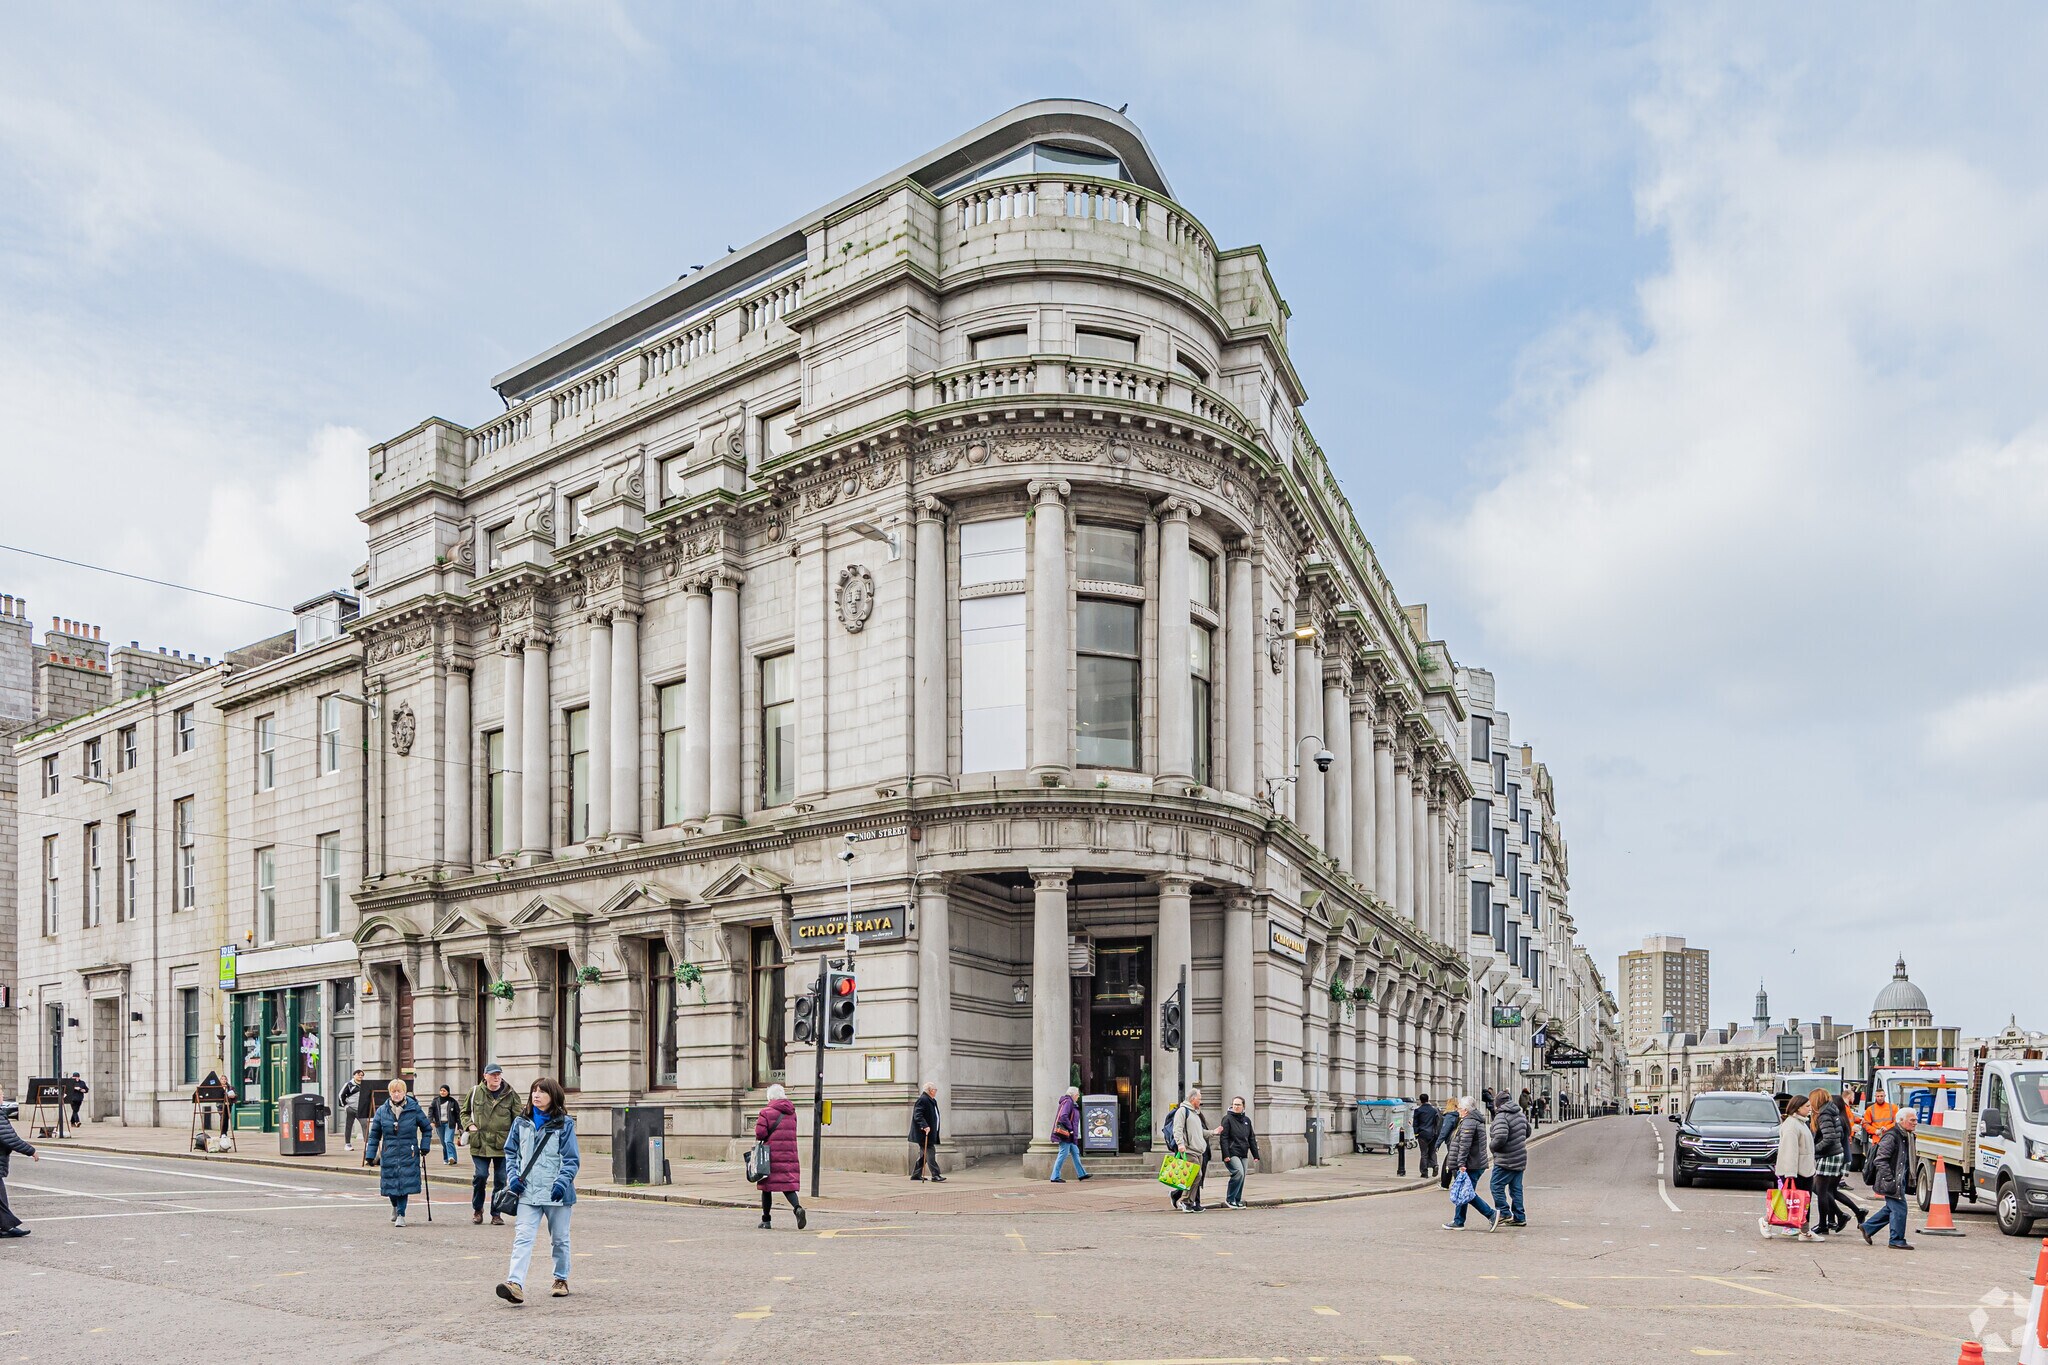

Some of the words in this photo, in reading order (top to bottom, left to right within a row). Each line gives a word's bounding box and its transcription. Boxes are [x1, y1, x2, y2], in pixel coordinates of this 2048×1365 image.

[857, 830, 876, 841] NION
[878, 826, 907, 838] STREET
[221, 947, 228, 955] TO
